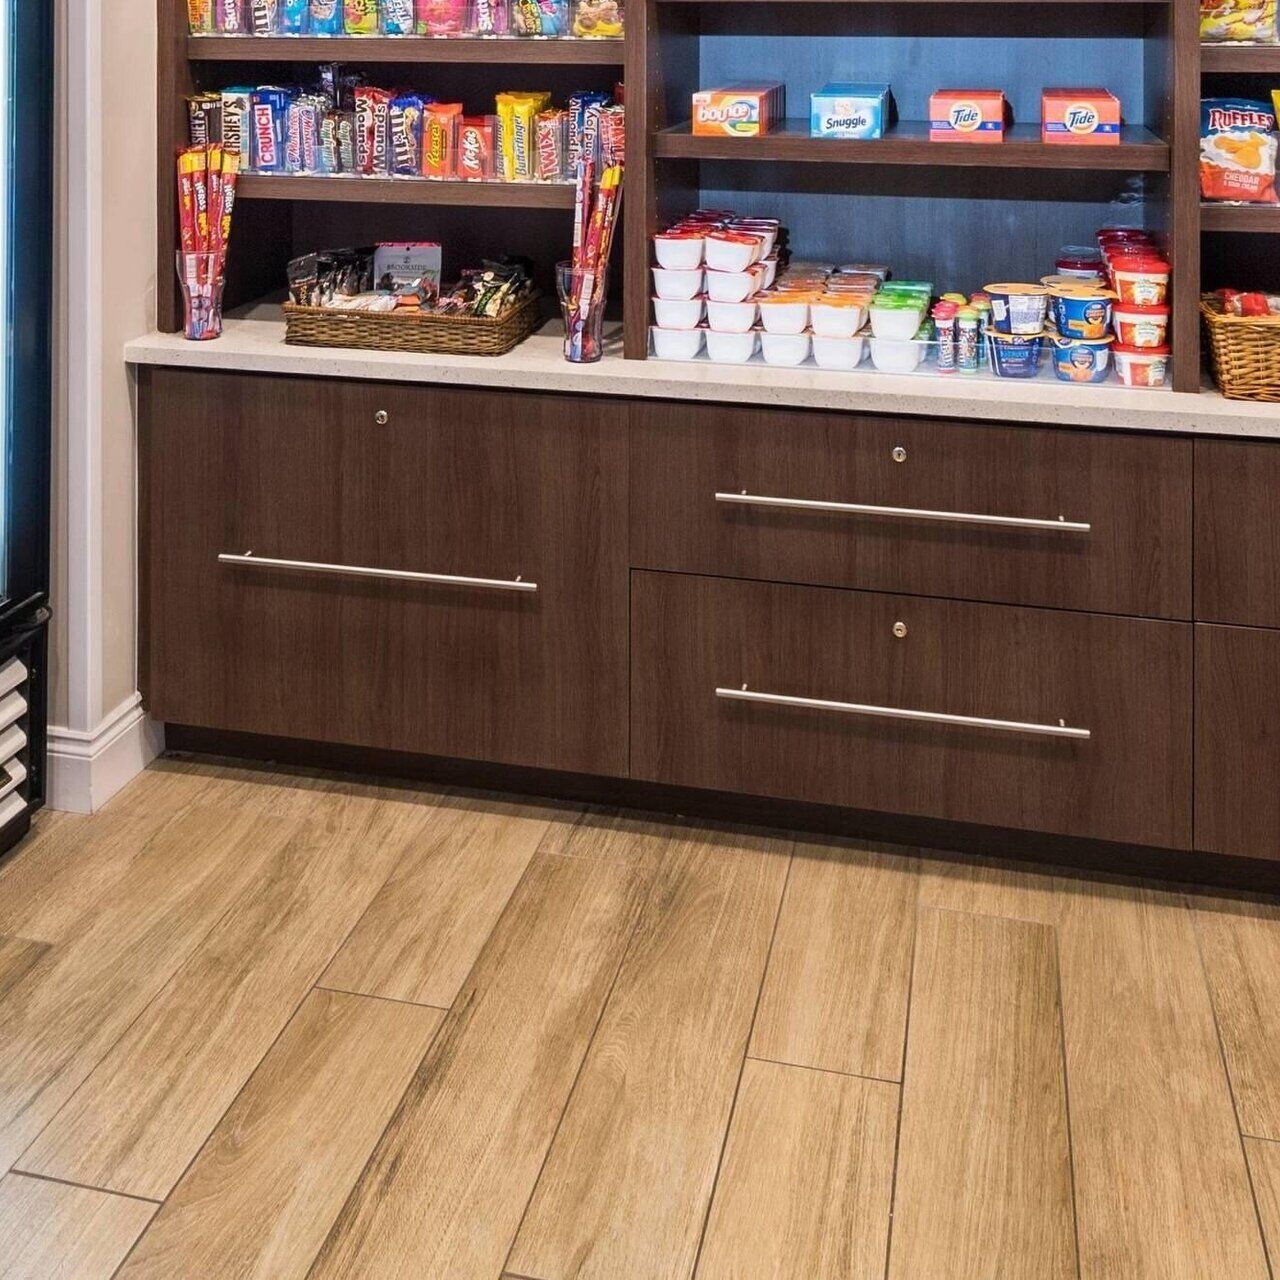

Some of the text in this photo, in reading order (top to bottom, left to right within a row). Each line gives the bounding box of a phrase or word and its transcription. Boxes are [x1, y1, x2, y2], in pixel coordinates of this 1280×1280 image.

[223, 100, 242, 155] ERSHEY'S
[256, 106, 275, 164] CRUNCH
[355, 98, 368, 165] Mounds
[373, 104, 387, 170] Mounds
[569, 98, 581, 170] Almond Joy
[583, 111, 598, 133] Joy
[825, 116, 868, 130] Snuggle
[953, 108, 978, 124] Tide
[1069, 111, 1096, 127] Tide
[1208, 108, 1275, 133] RUFFLES
[513, 114, 527, 176] Butterfinger
[538, 129, 559, 178] TWIX
